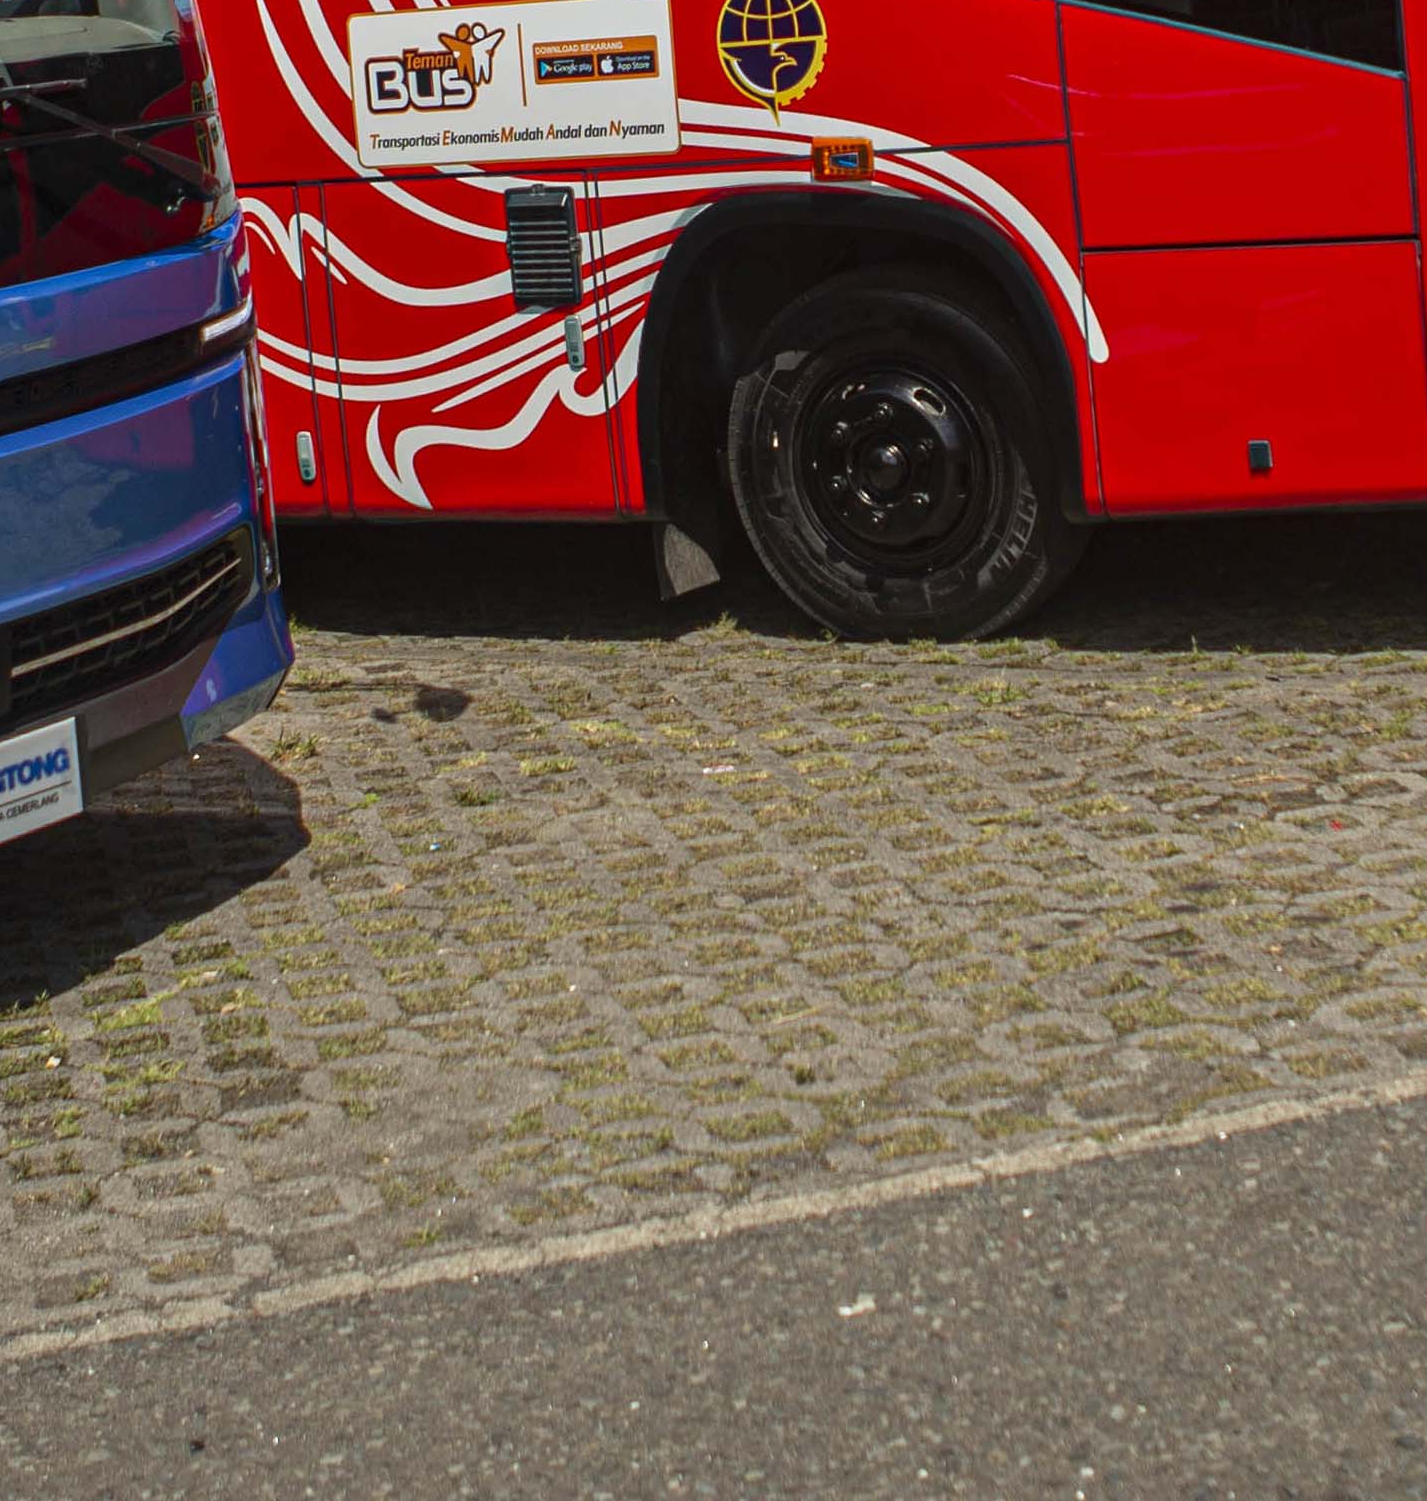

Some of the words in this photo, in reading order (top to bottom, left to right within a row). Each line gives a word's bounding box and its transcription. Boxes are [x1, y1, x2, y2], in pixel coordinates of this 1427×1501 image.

[404, 51, 454, 70] Teman
[370, 133, 440, 150] Transportasi
[442, 130, 500, 147] Ekonomis
[500, 126, 544, 144] Mudah
[546, 123, 582, 140] Andal
[584, 123, 608, 139] dan
[608, 119, 665, 139] Nyaman
